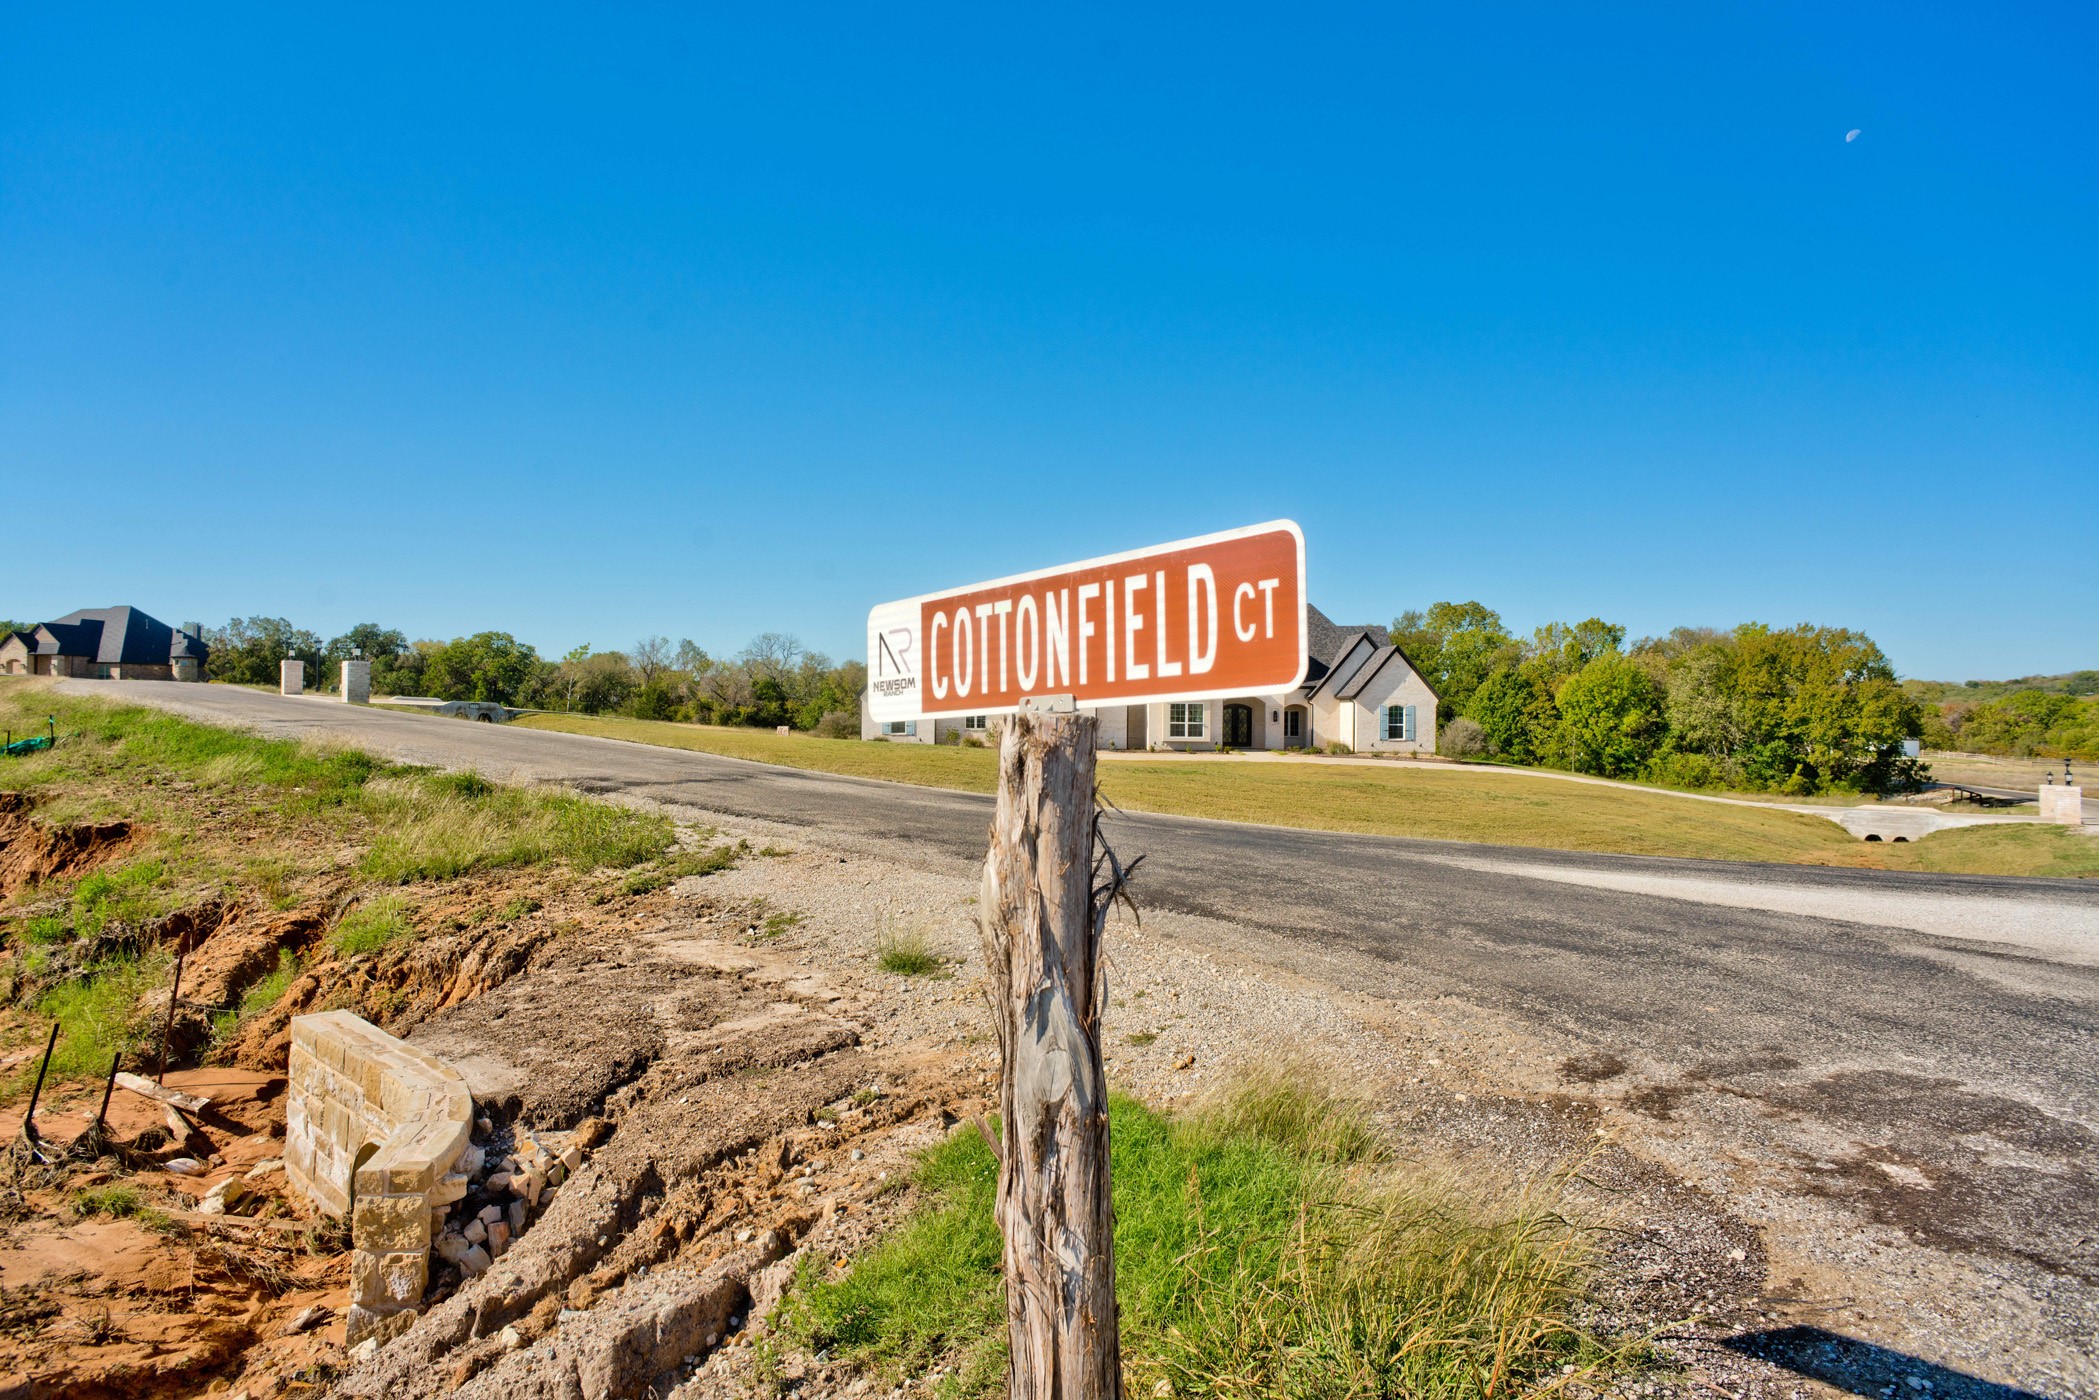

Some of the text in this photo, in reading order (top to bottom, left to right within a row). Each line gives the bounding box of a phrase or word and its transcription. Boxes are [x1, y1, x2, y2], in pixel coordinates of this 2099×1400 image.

[930, 562, 1280, 700] COTTONFIELD CT
[873, 677, 916, 692] NEWSOM
